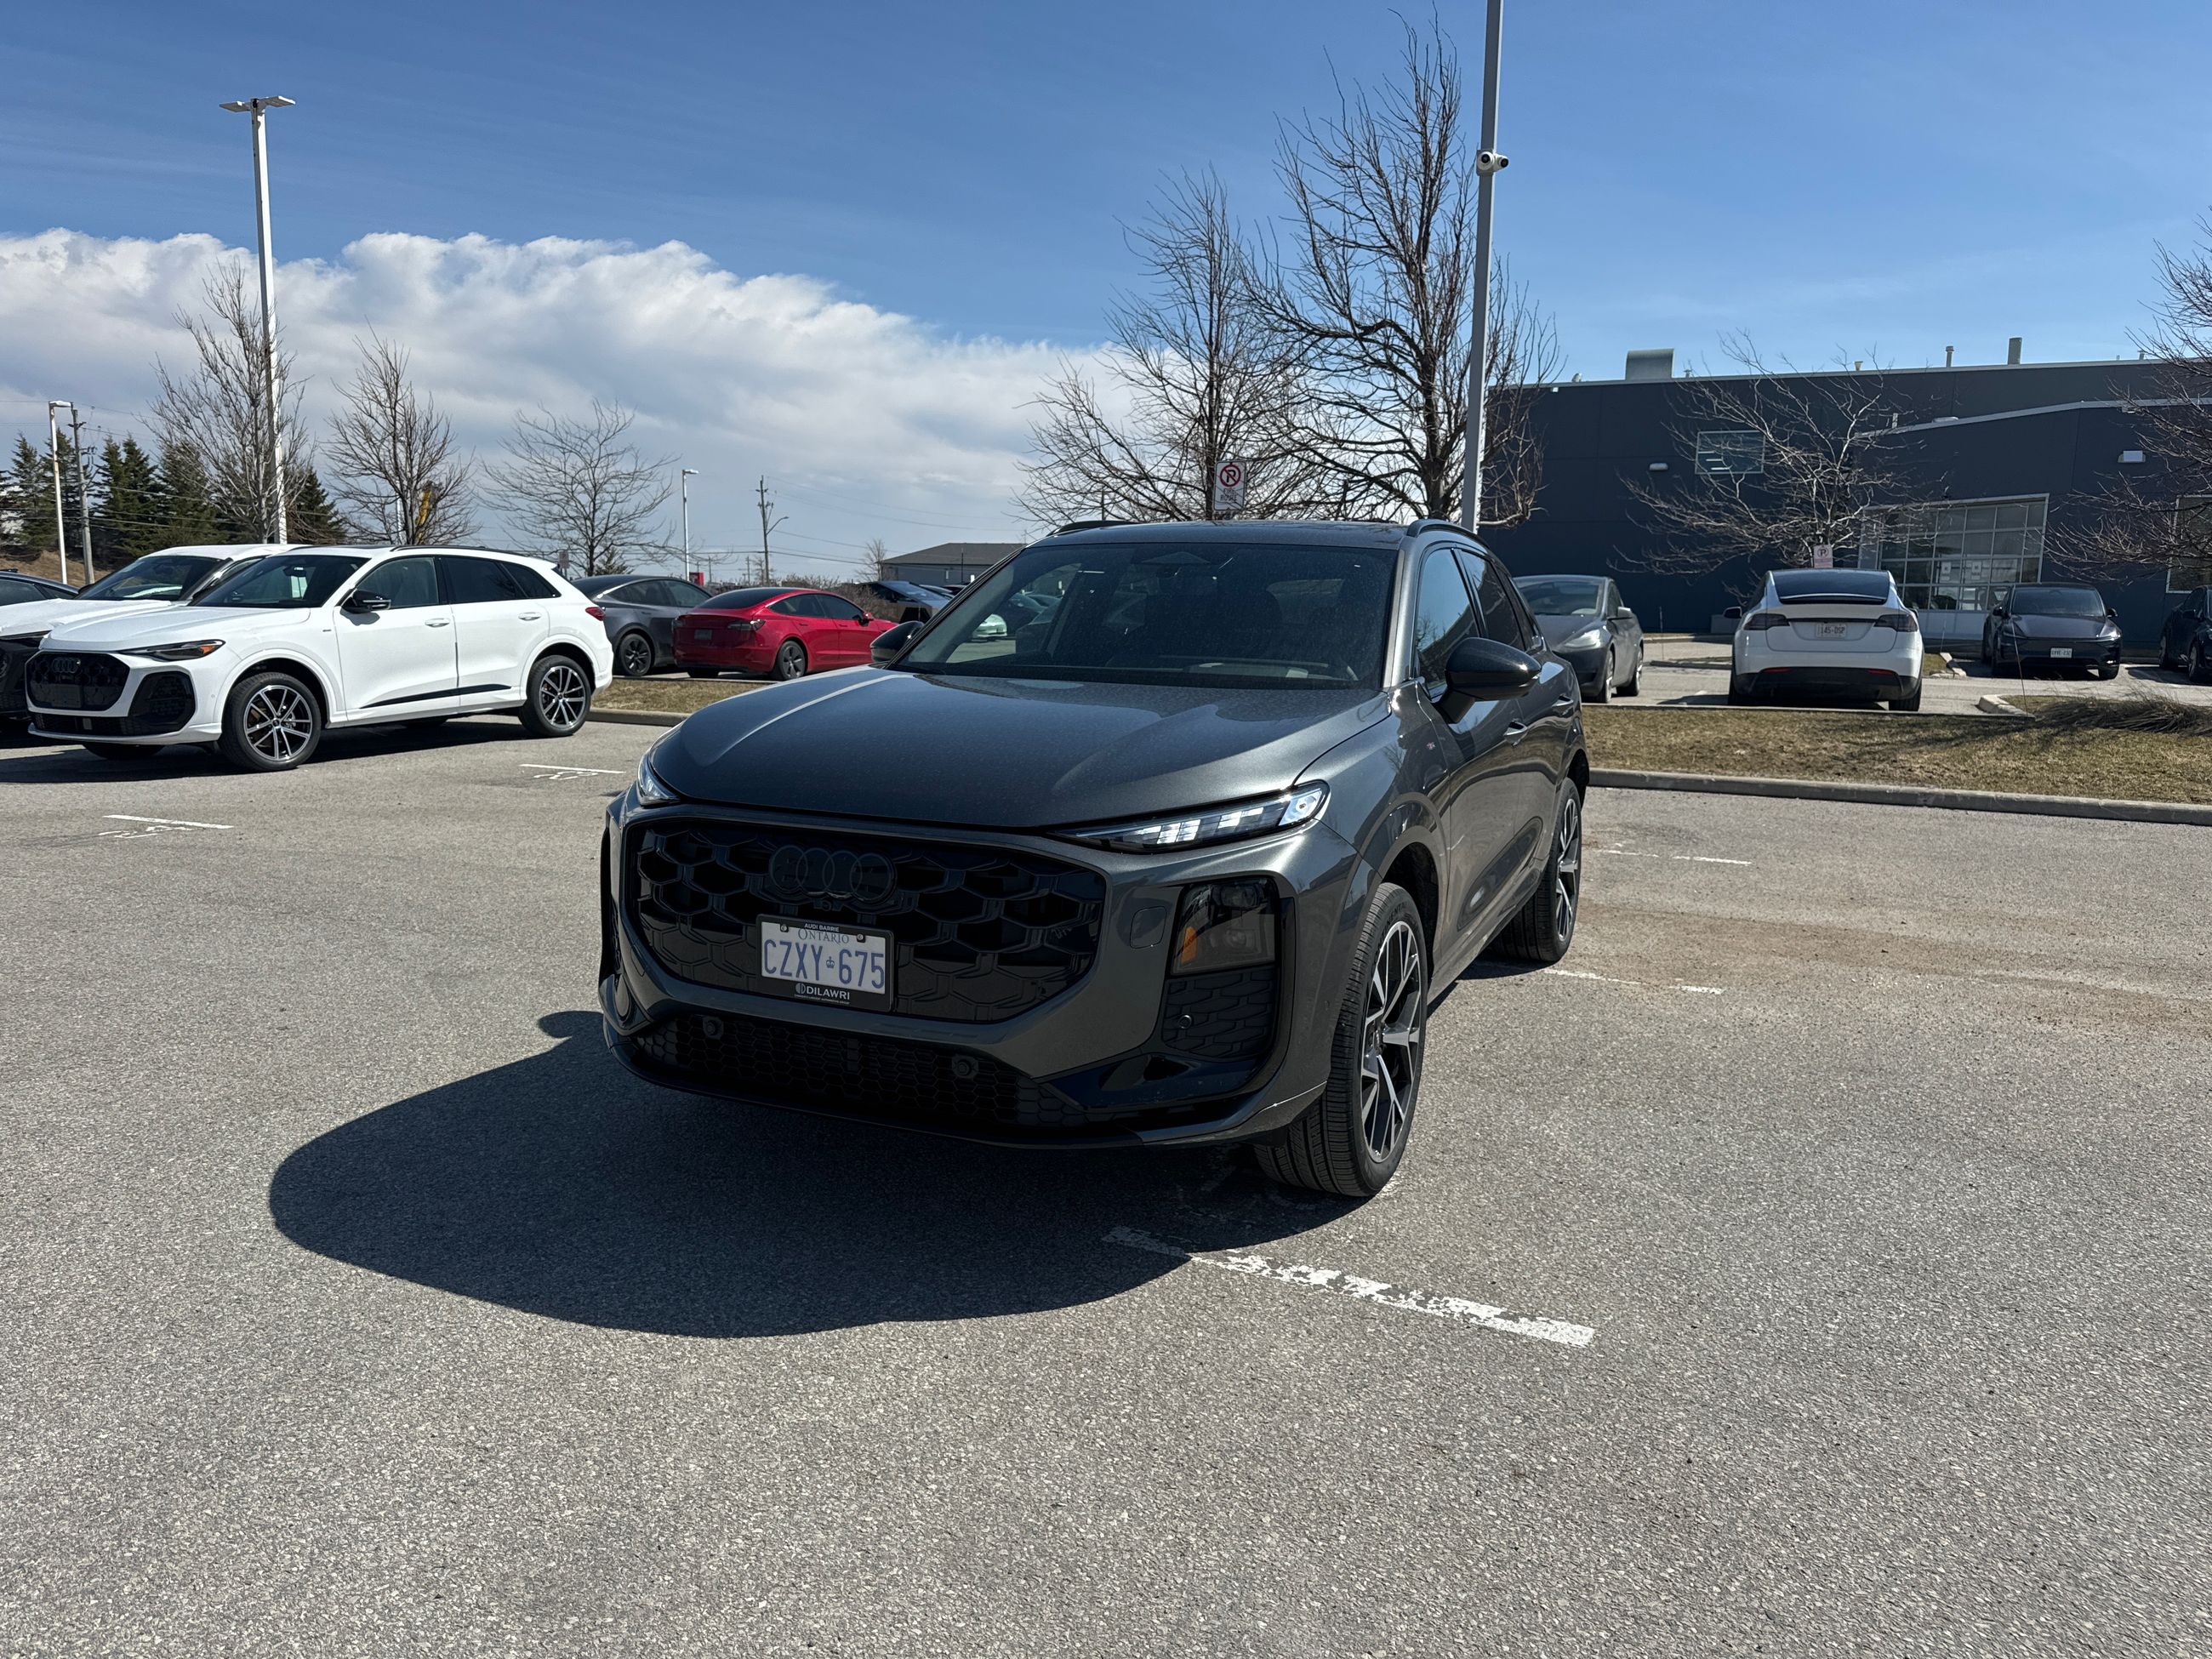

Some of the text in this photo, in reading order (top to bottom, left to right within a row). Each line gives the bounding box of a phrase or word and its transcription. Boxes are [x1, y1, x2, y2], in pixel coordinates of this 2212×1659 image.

[798, 928, 849, 945] ONTARIO
[764, 939, 885, 989] CZXY 675
[806, 985, 850, 1001] DILAWRI
